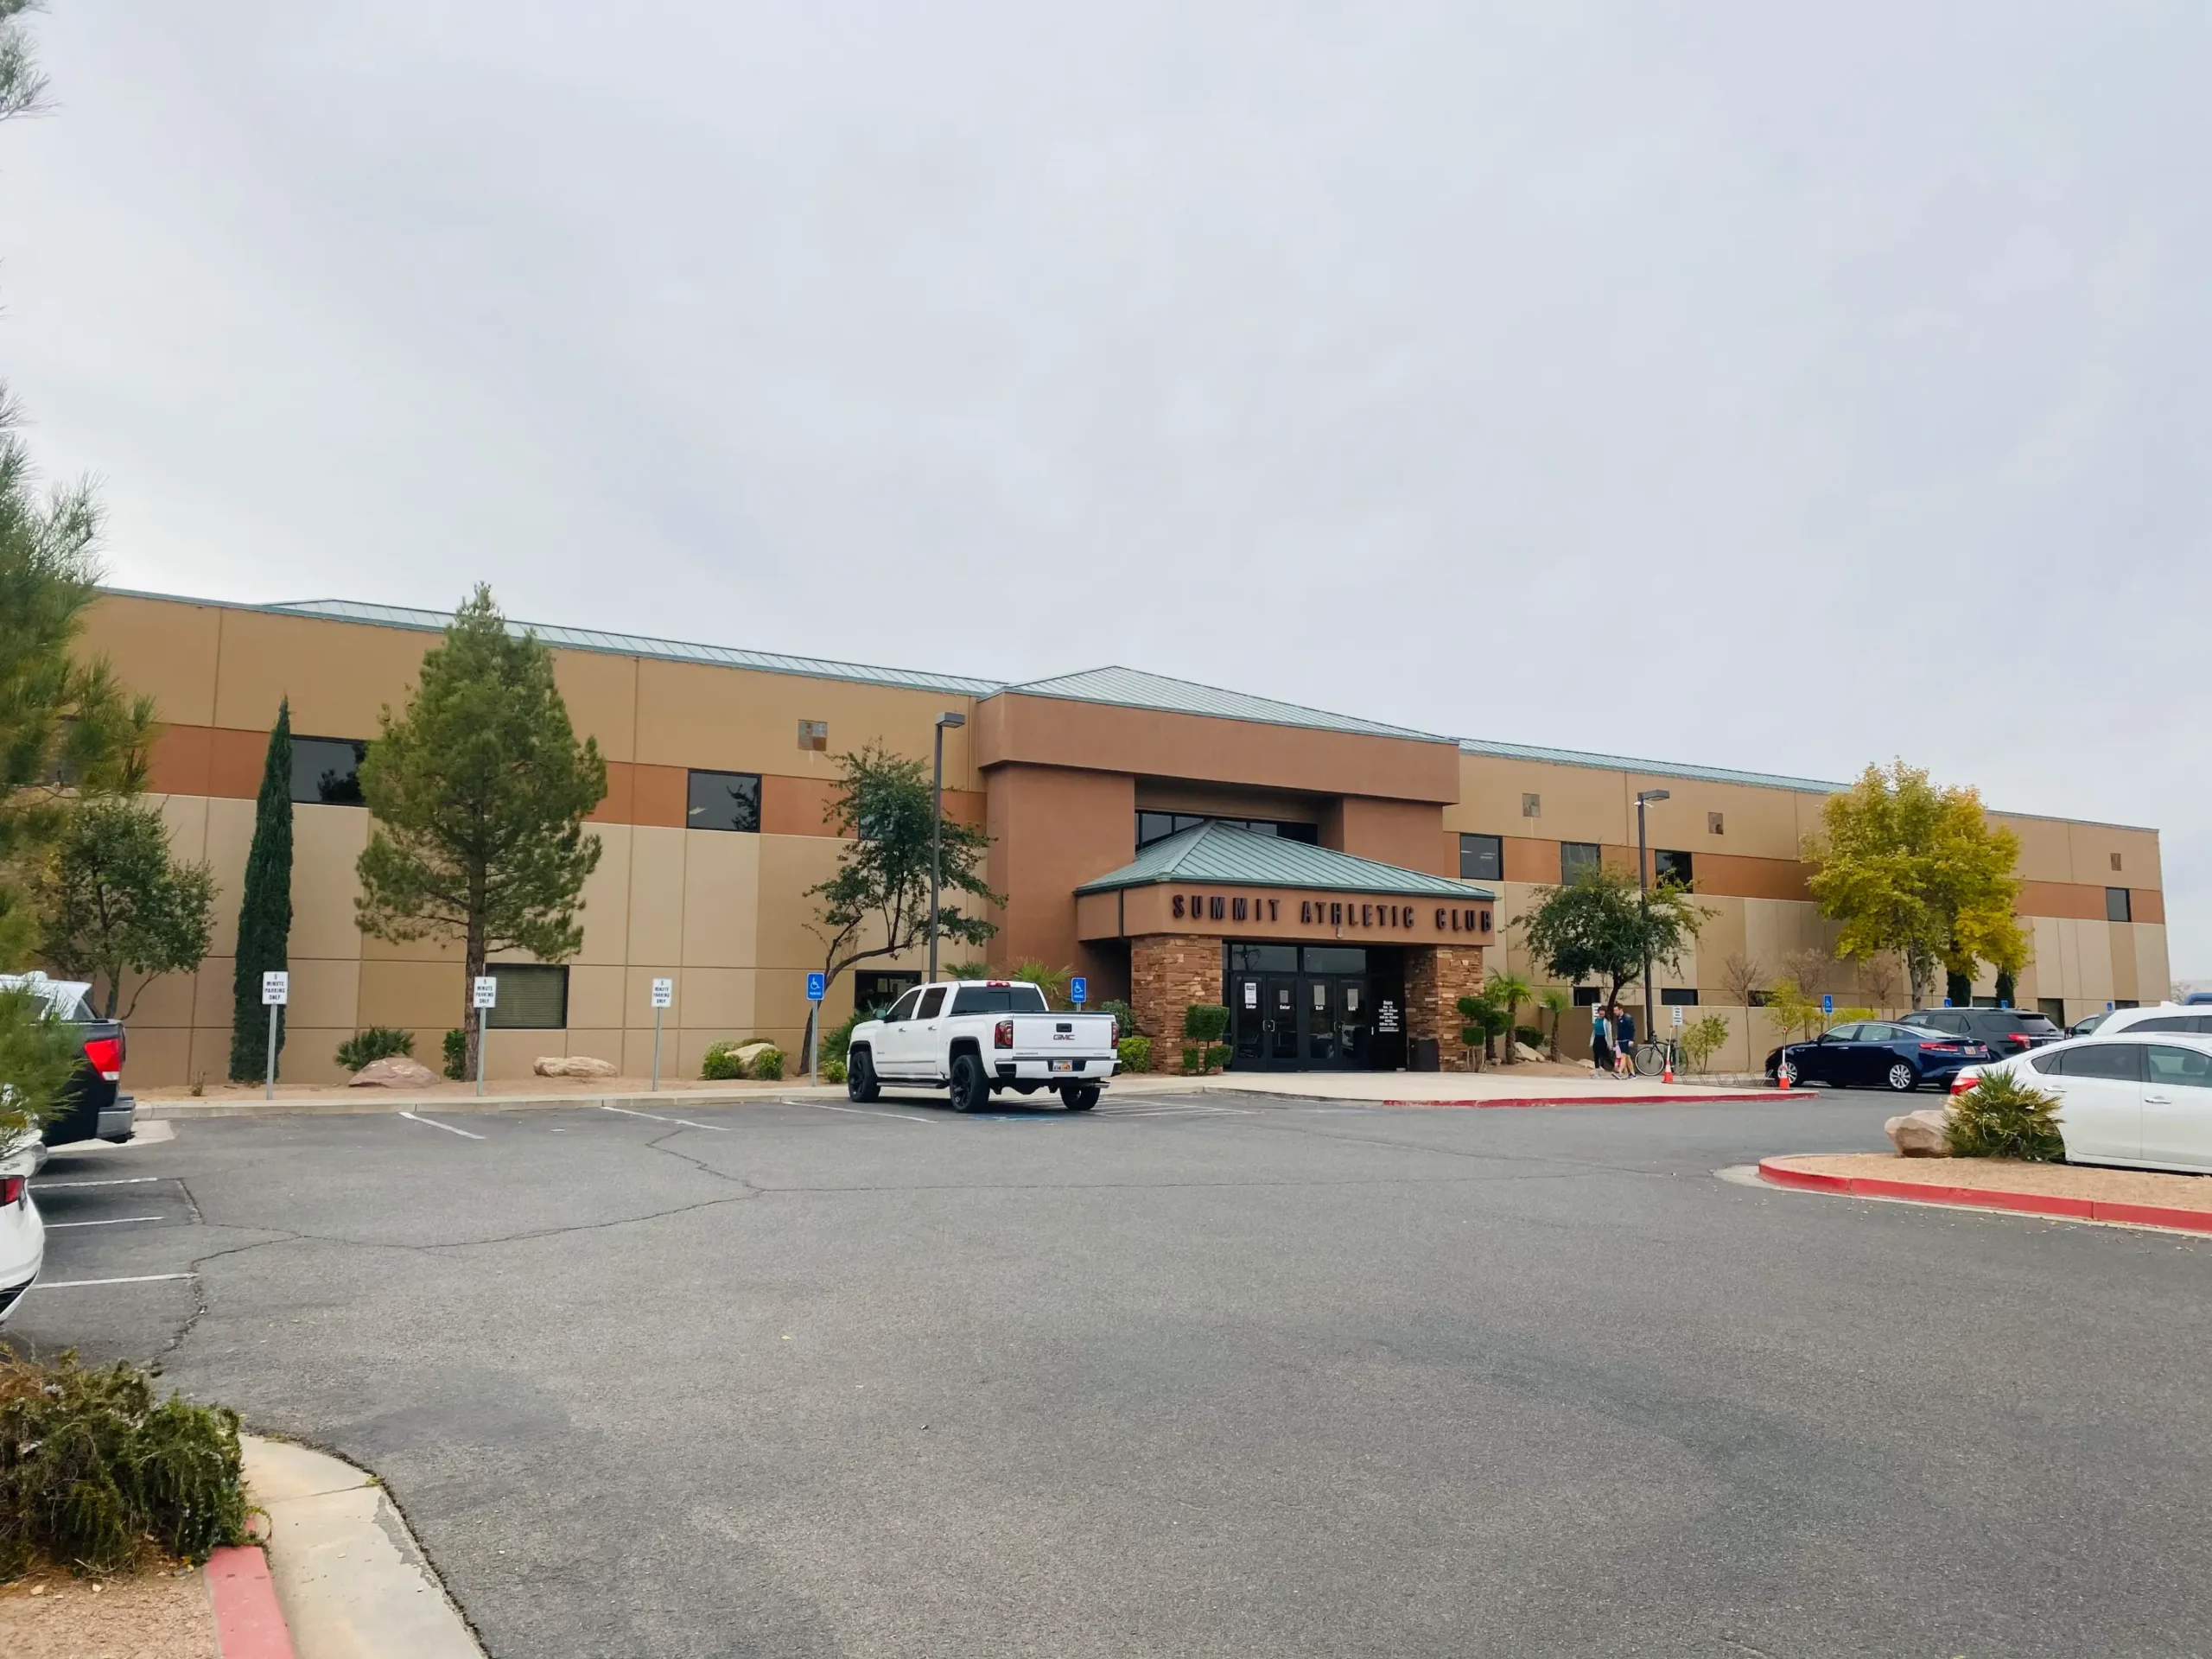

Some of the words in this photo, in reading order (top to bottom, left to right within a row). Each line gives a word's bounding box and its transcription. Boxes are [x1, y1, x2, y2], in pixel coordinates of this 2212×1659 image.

[1173, 894, 1280, 922] SUMMIT
[1300, 901, 1414, 928] ATHLETIC
[1435, 908, 1491, 931] CLUB
